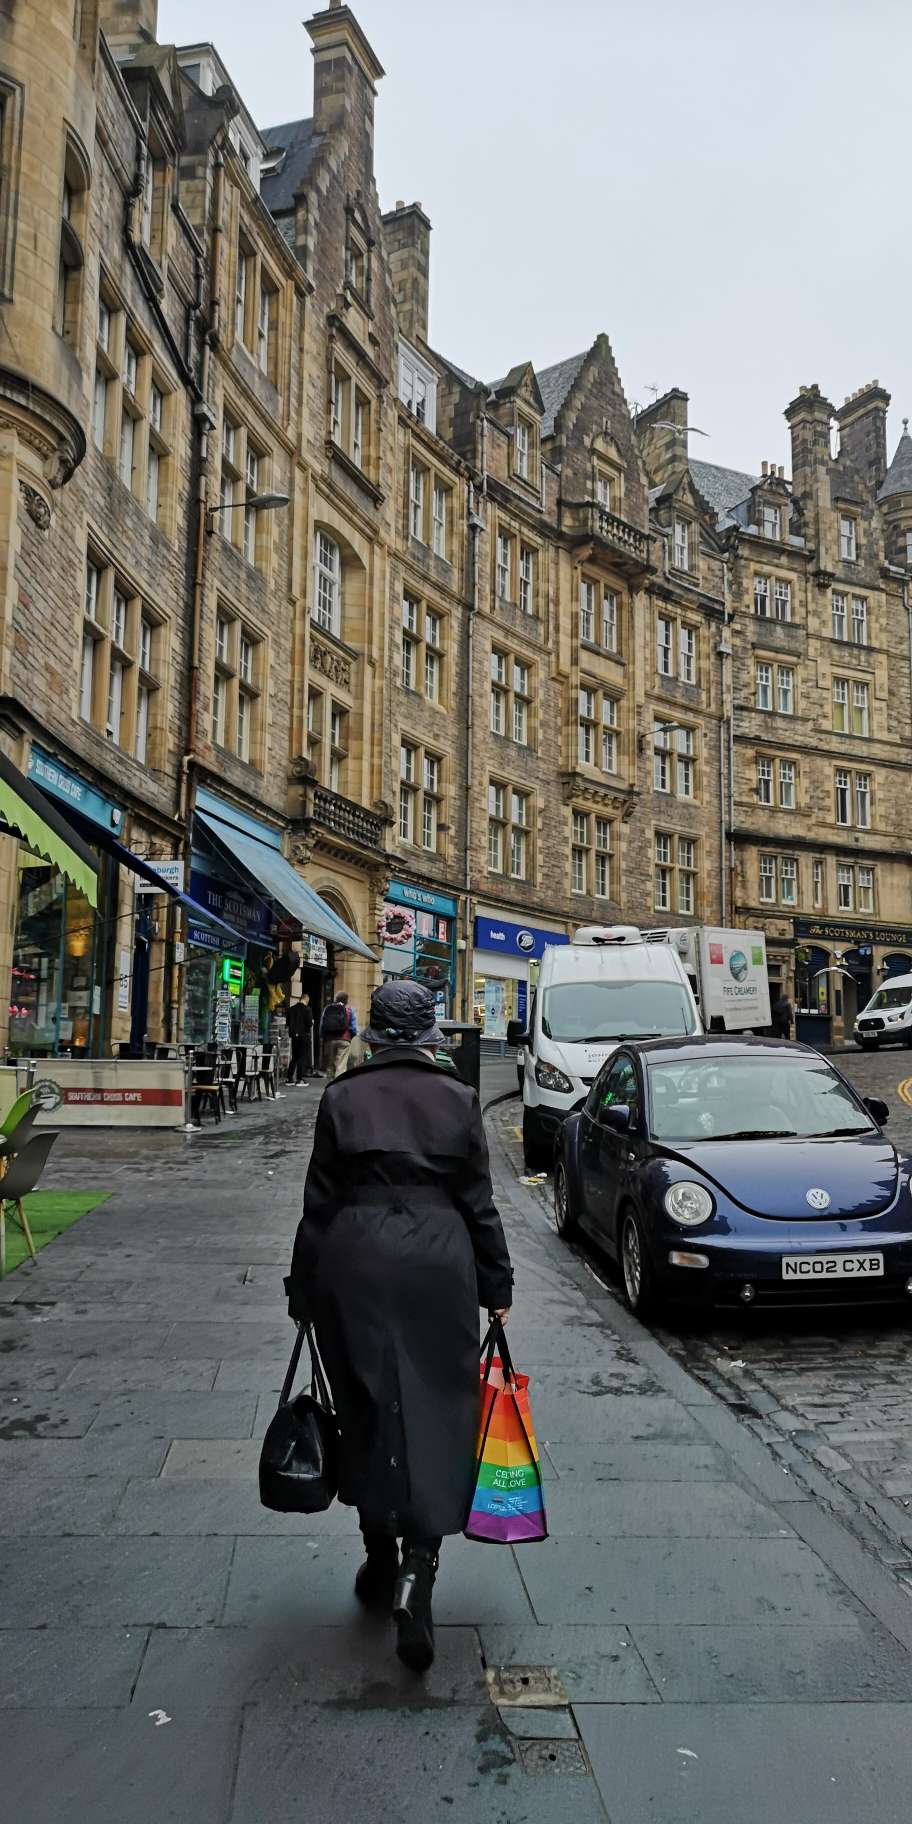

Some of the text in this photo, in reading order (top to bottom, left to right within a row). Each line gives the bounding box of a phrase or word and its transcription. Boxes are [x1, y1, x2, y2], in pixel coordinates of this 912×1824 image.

[35, 759, 58, 785] SOUTHERN
[70, 783, 81, 801] CAFE
[207, 890, 223, 908] THE
[224, 898, 263, 922] SCOTSMAN
[193, 929, 220, 946] SCOTTISH
[490, 929, 506, 941] health
[808, 926, 907, 943] The SCOTSMAN'S LOUNGE
[67, 1092, 142, 1102] SOUTHERN CROSS CAFE
[842, 1258, 881, 1272] CXB
[492, 1478, 507, 1488] ALL
